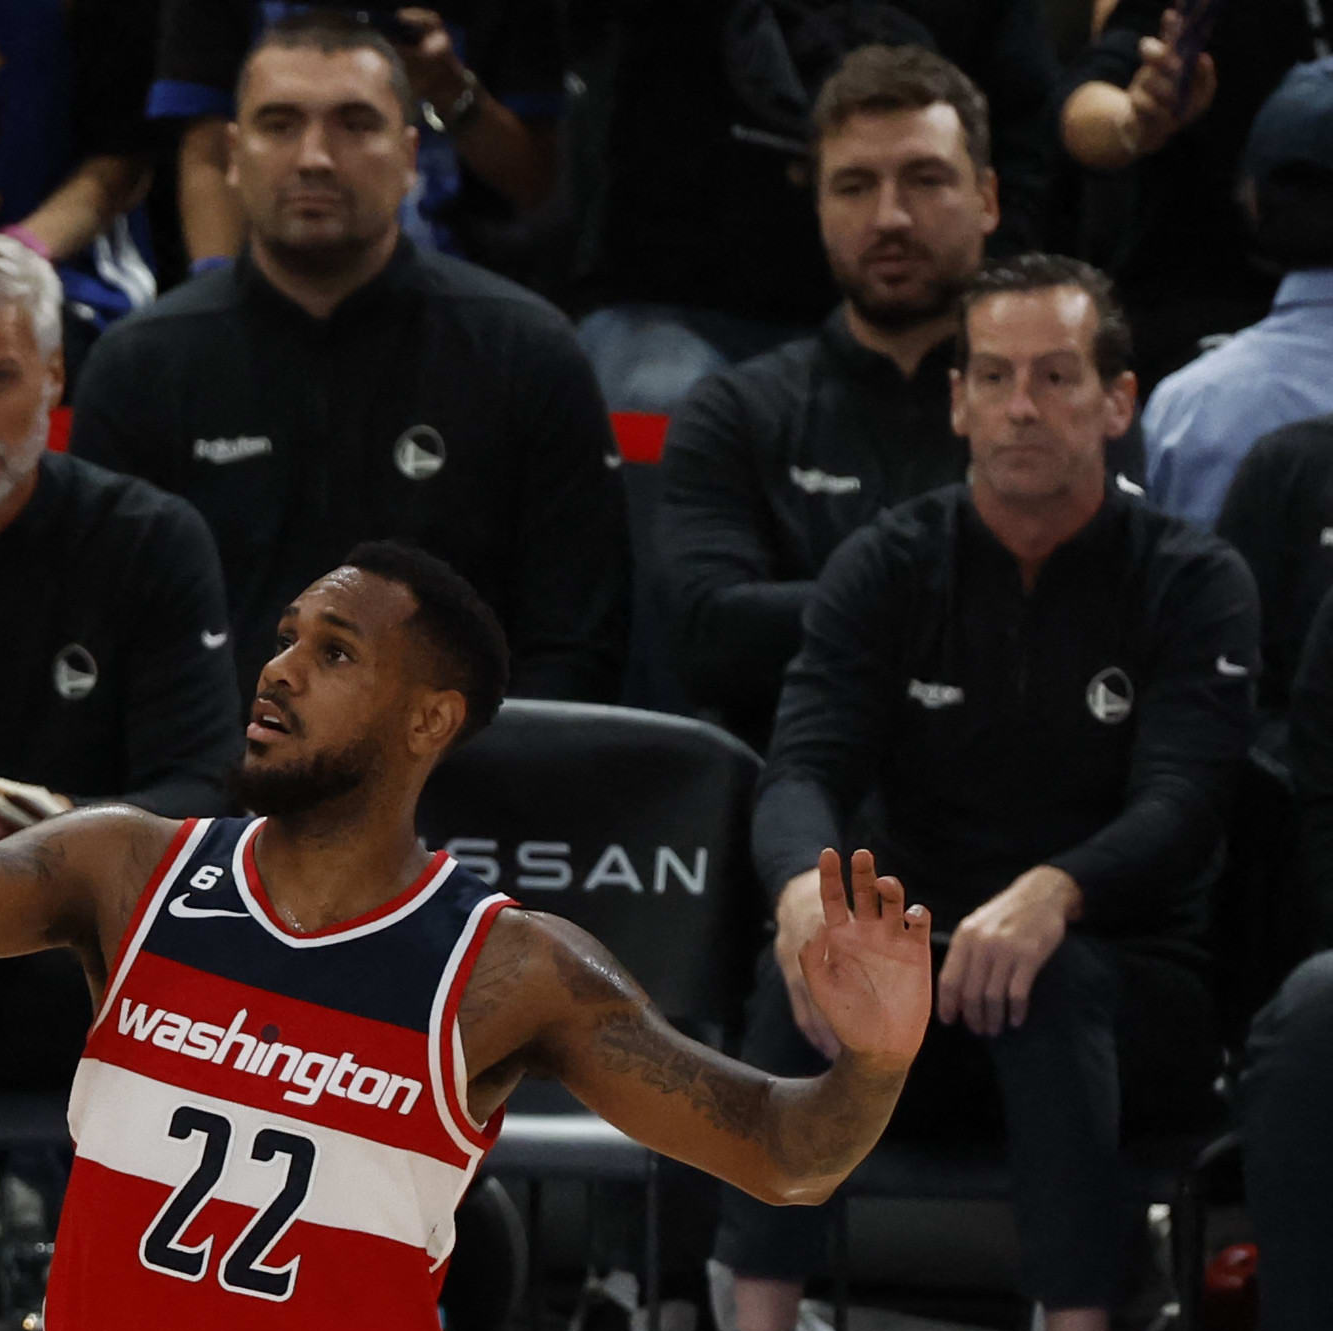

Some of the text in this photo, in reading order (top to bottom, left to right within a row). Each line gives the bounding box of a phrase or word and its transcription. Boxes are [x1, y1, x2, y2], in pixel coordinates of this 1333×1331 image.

[189, 865, 224, 890] 6
[419, 837, 708, 894] SSAN
[117, 998, 423, 1115] washington
[138, 1105, 316, 1302] 22
